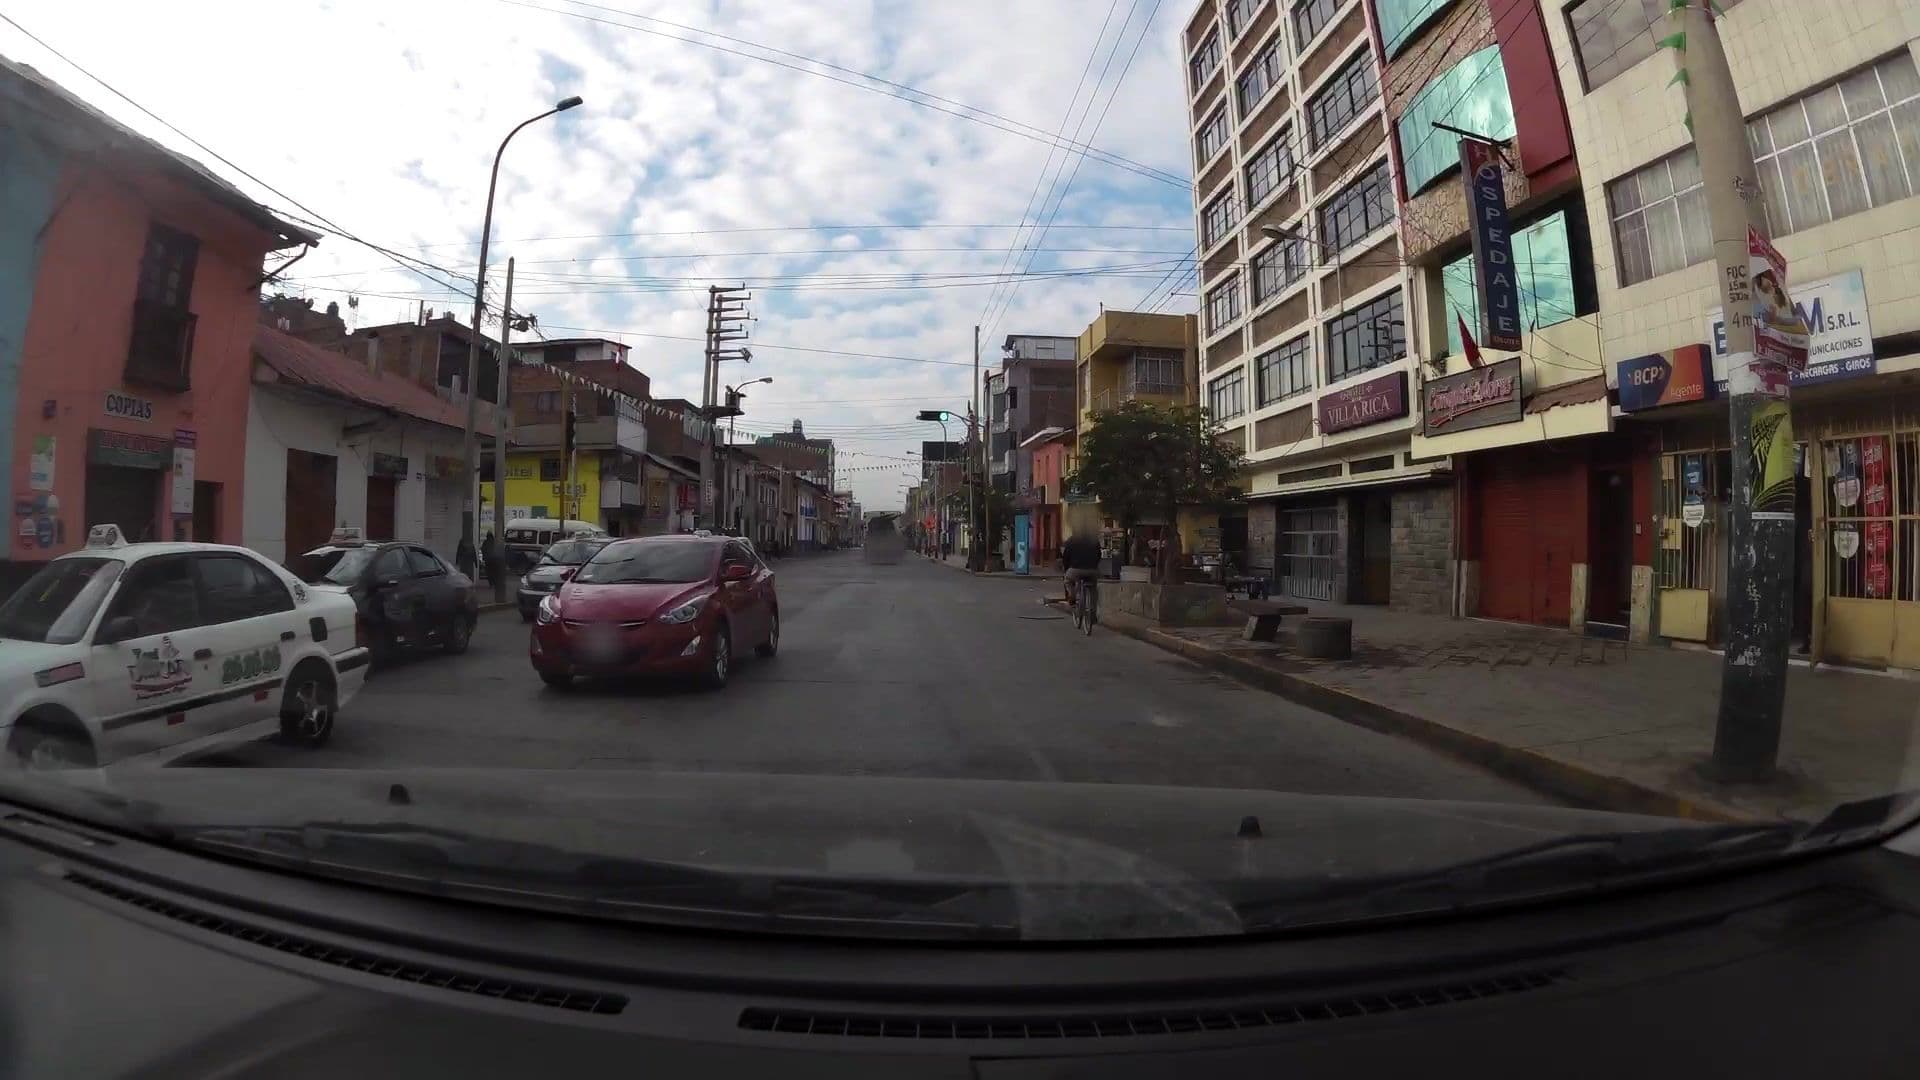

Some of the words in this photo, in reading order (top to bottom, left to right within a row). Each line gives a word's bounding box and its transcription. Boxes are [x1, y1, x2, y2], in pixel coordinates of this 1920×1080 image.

[1473, 144, 1515, 333] HOSPEDAJE
[1845, 358, 1871, 371] GIROS
[1634, 366, 1658, 386] BCP
[1670, 384, 1701, 398] Agente
[106, 393, 153, 419] COPIAS
